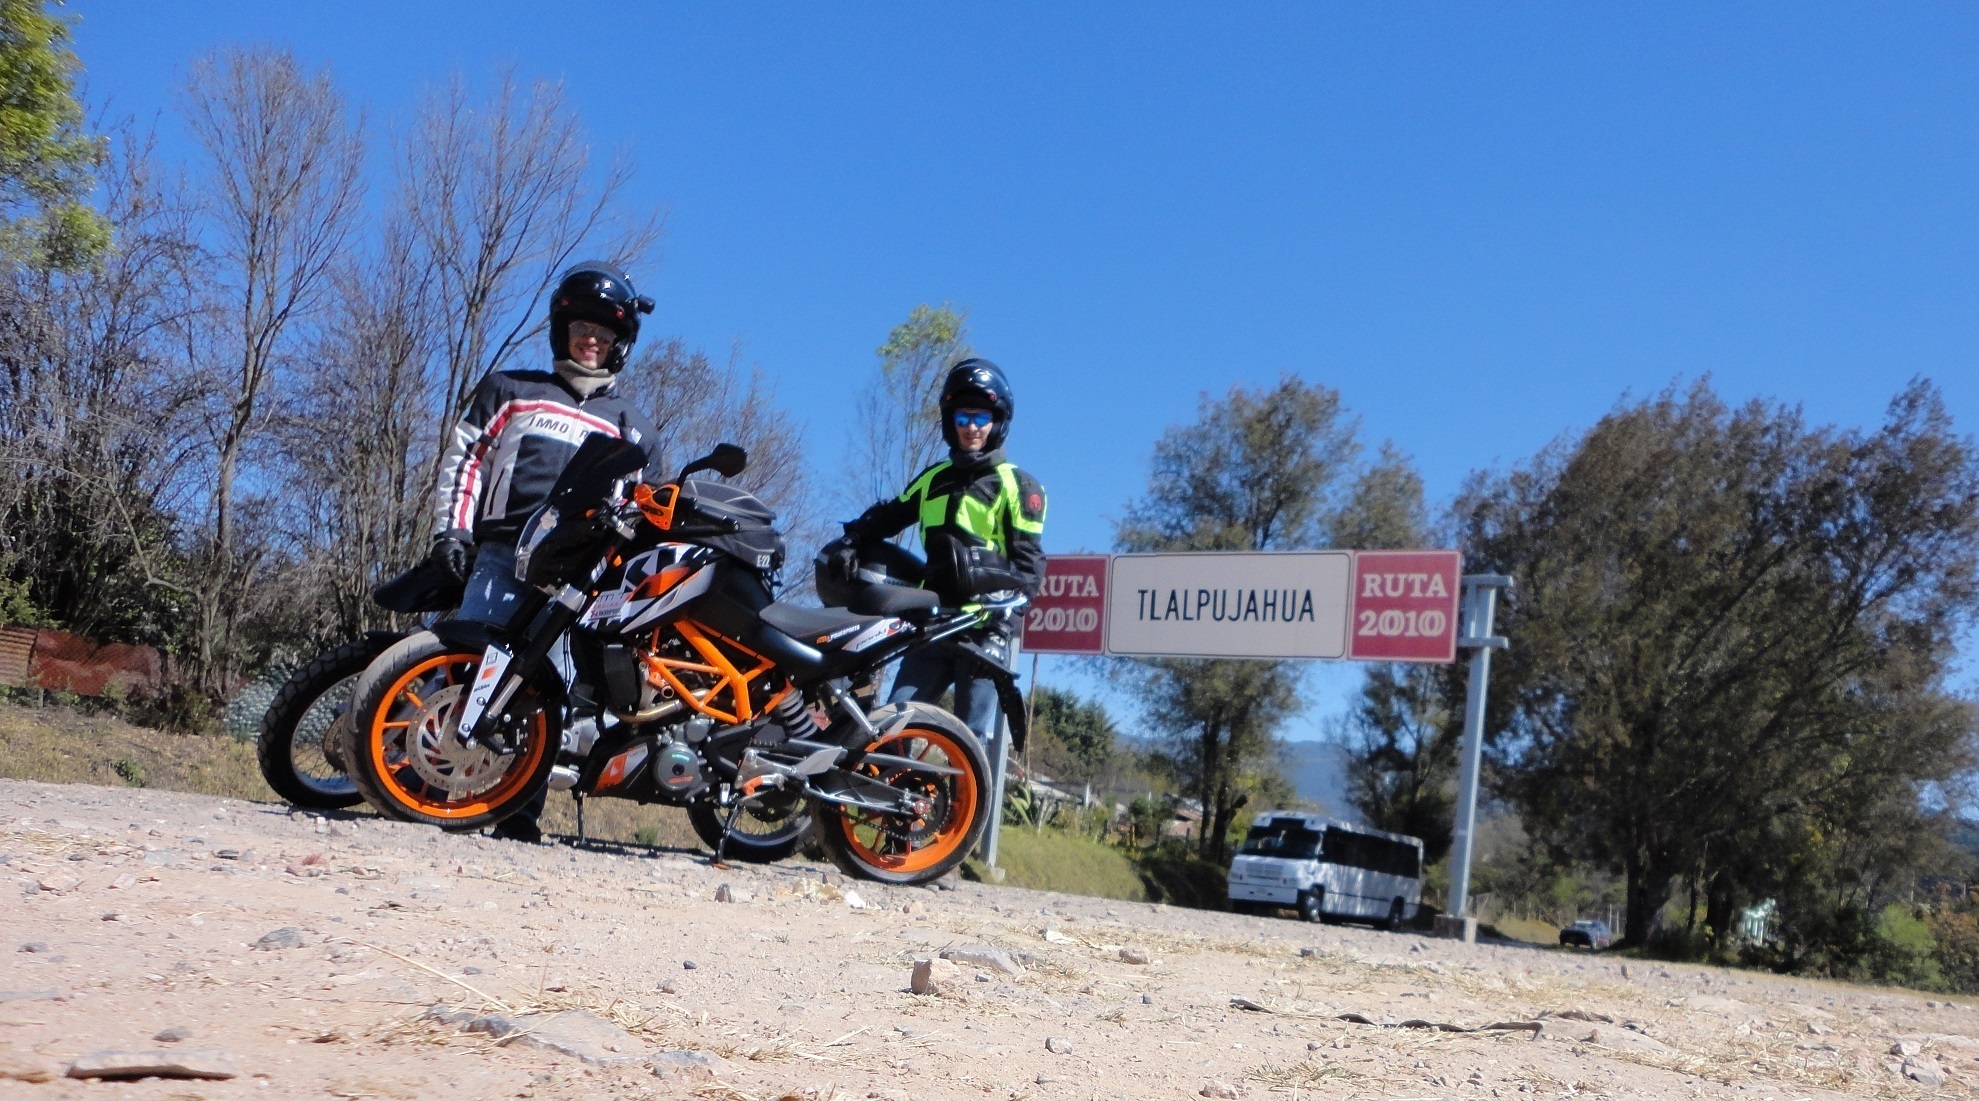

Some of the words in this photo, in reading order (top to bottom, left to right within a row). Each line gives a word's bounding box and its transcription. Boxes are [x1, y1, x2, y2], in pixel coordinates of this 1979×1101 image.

[1361, 573, 1449, 598] RUTA
[1137, 588, 1315, 622] TLALPUJAHUA
[1028, 607, 1098, 632] 2010
[1358, 610, 1446, 637] 2010
